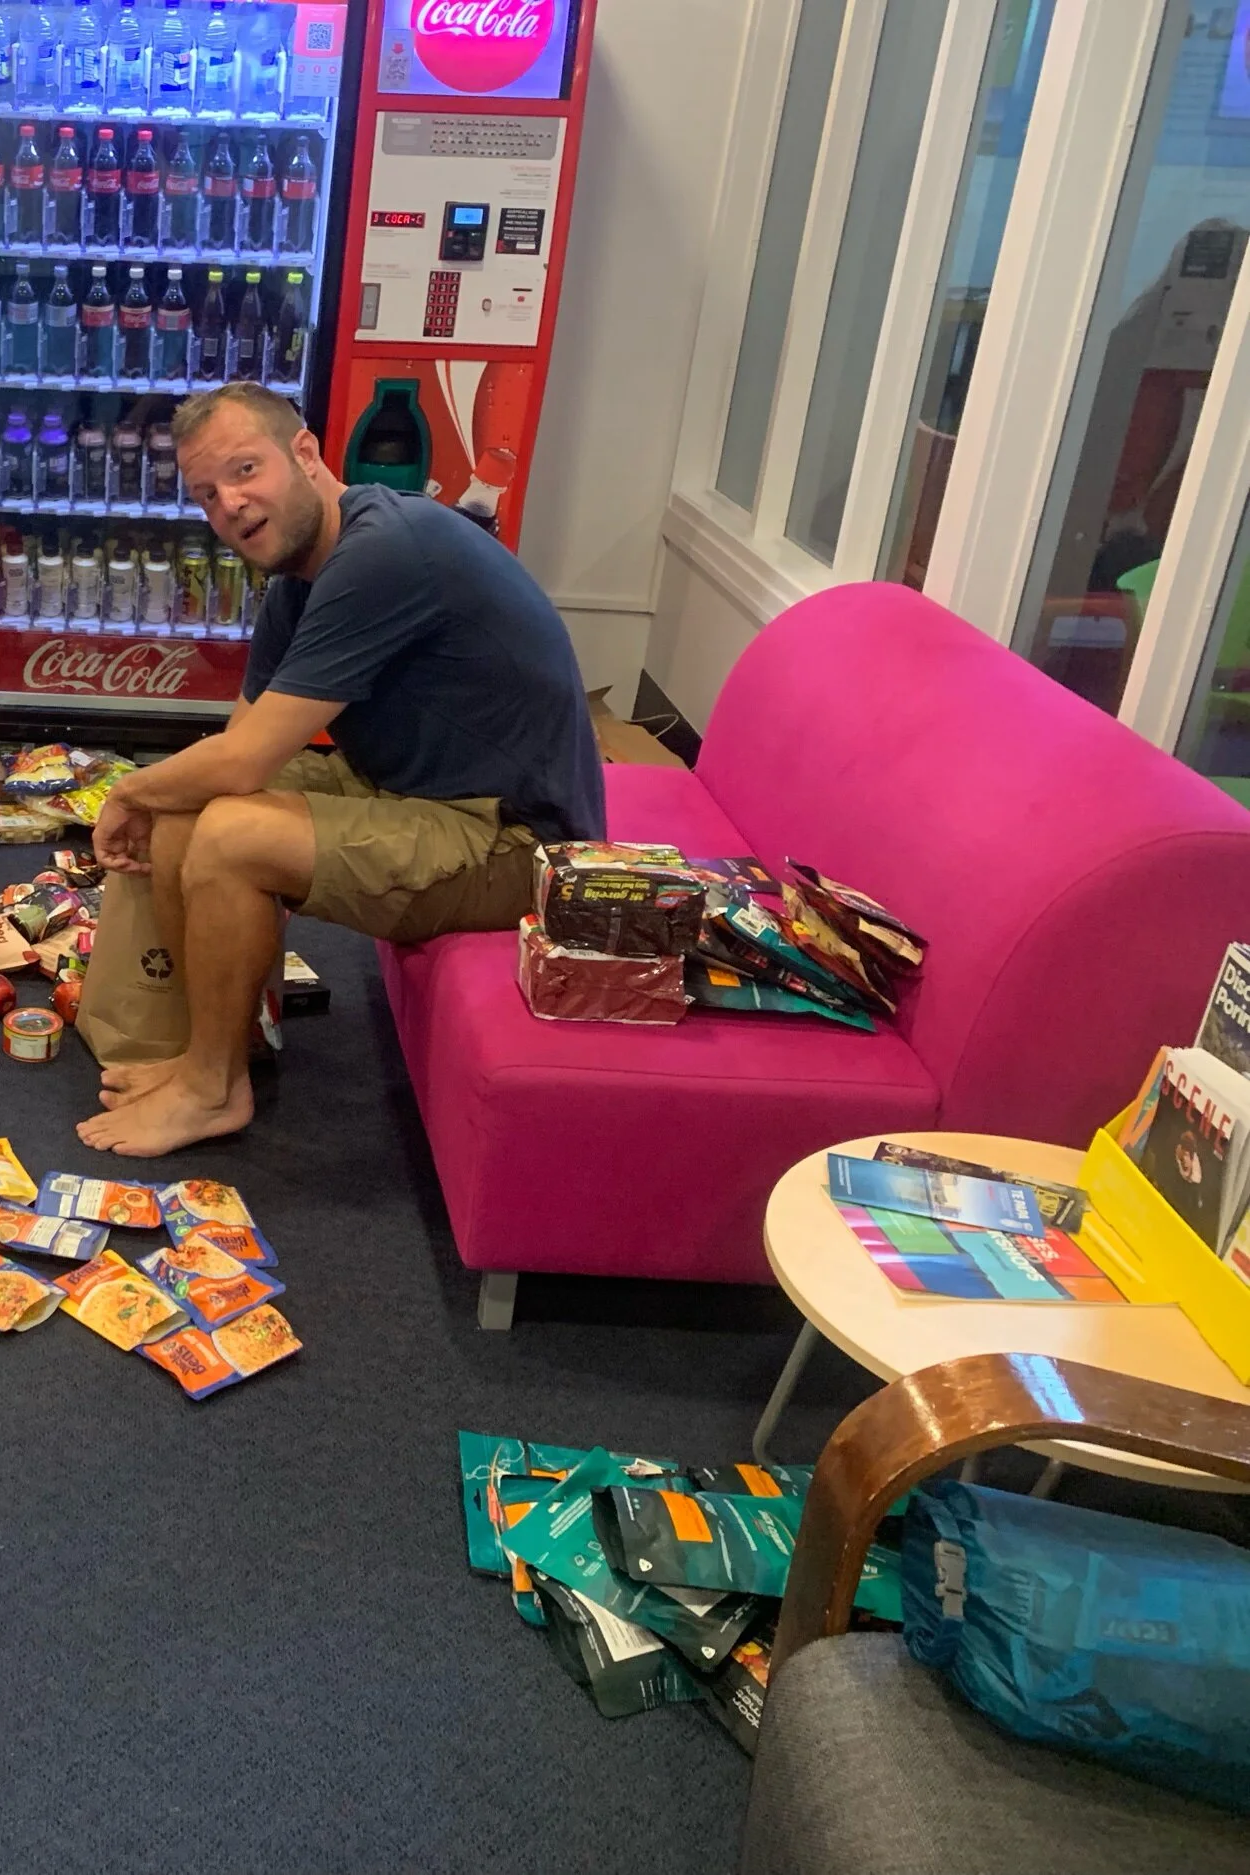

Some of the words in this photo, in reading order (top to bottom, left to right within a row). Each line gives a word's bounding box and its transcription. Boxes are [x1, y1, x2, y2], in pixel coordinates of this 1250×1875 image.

[417, 0, 544, 37] Coca-Cola
[22, 638, 199, 694] Coca-Cola
[560, 883, 575, 900] 5
[1160, 1059, 1233, 1159] SCENE
[1011, 1189, 1025, 1200] TE
[1013, 1199, 1030, 1219] PAPA
